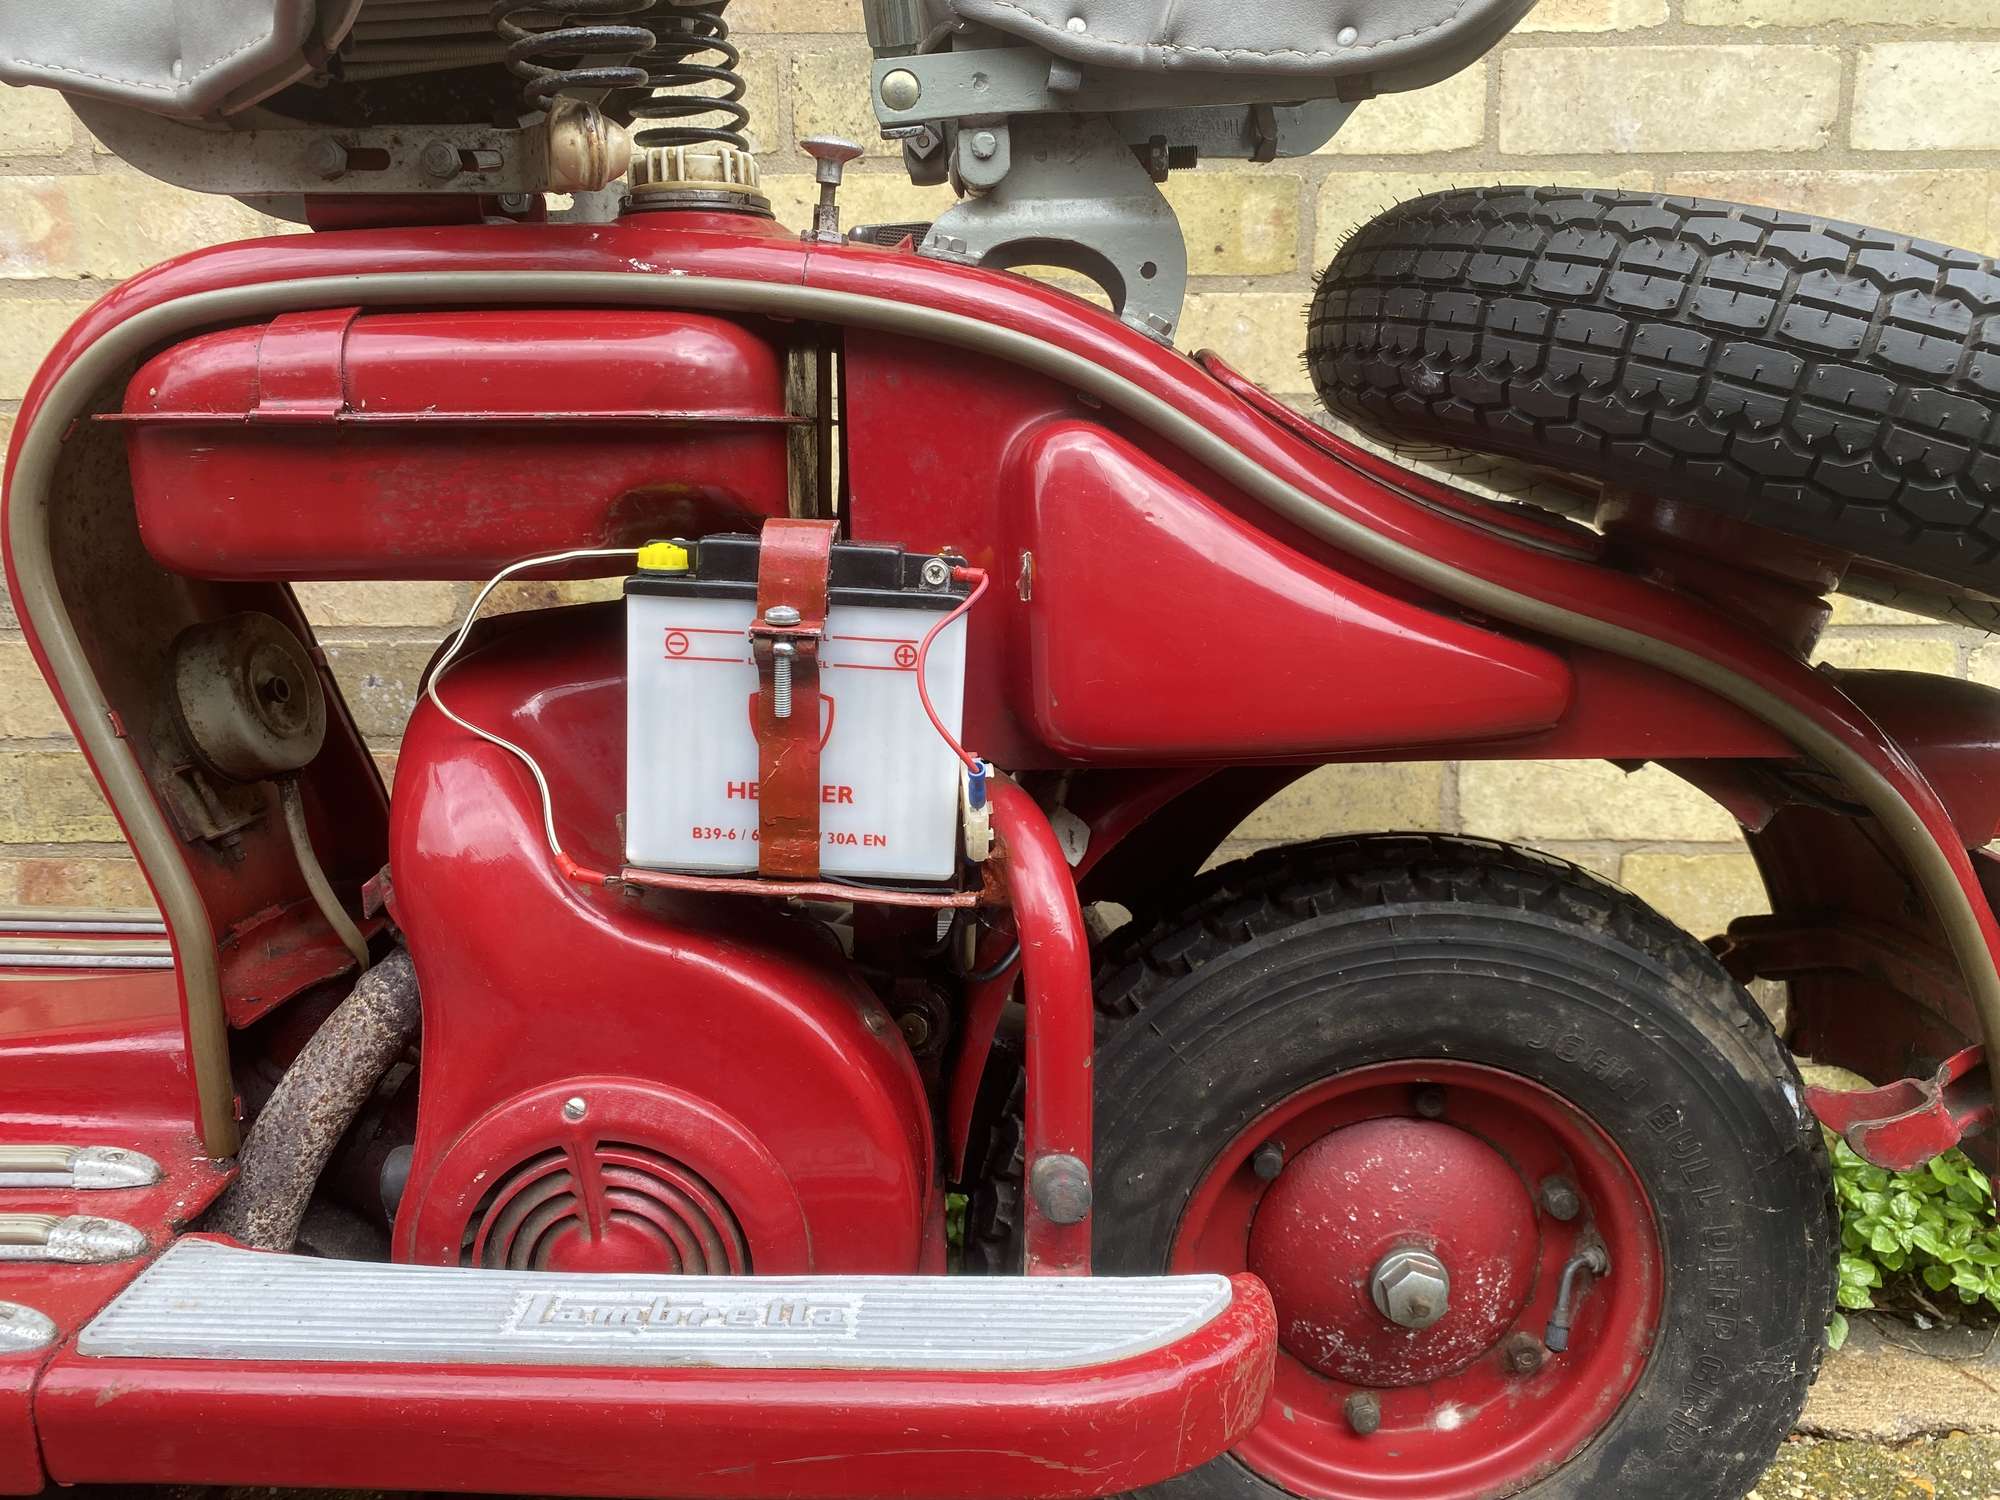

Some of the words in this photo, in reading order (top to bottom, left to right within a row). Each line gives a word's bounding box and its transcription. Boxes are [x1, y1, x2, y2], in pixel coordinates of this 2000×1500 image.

[692, 827, 737, 841] B39-6
[827, 832, 858, 845] 30A
[863, 834, 887, 847] EN
[1527, 1024, 1649, 1101] JOHN
[1644, 1103, 1725, 1208] BULL
[517, 1293, 849, 1329] Lambretta
[1703, 1225, 1743, 1340] DEEP
[1665, 1354, 1727, 1454] GRIP
